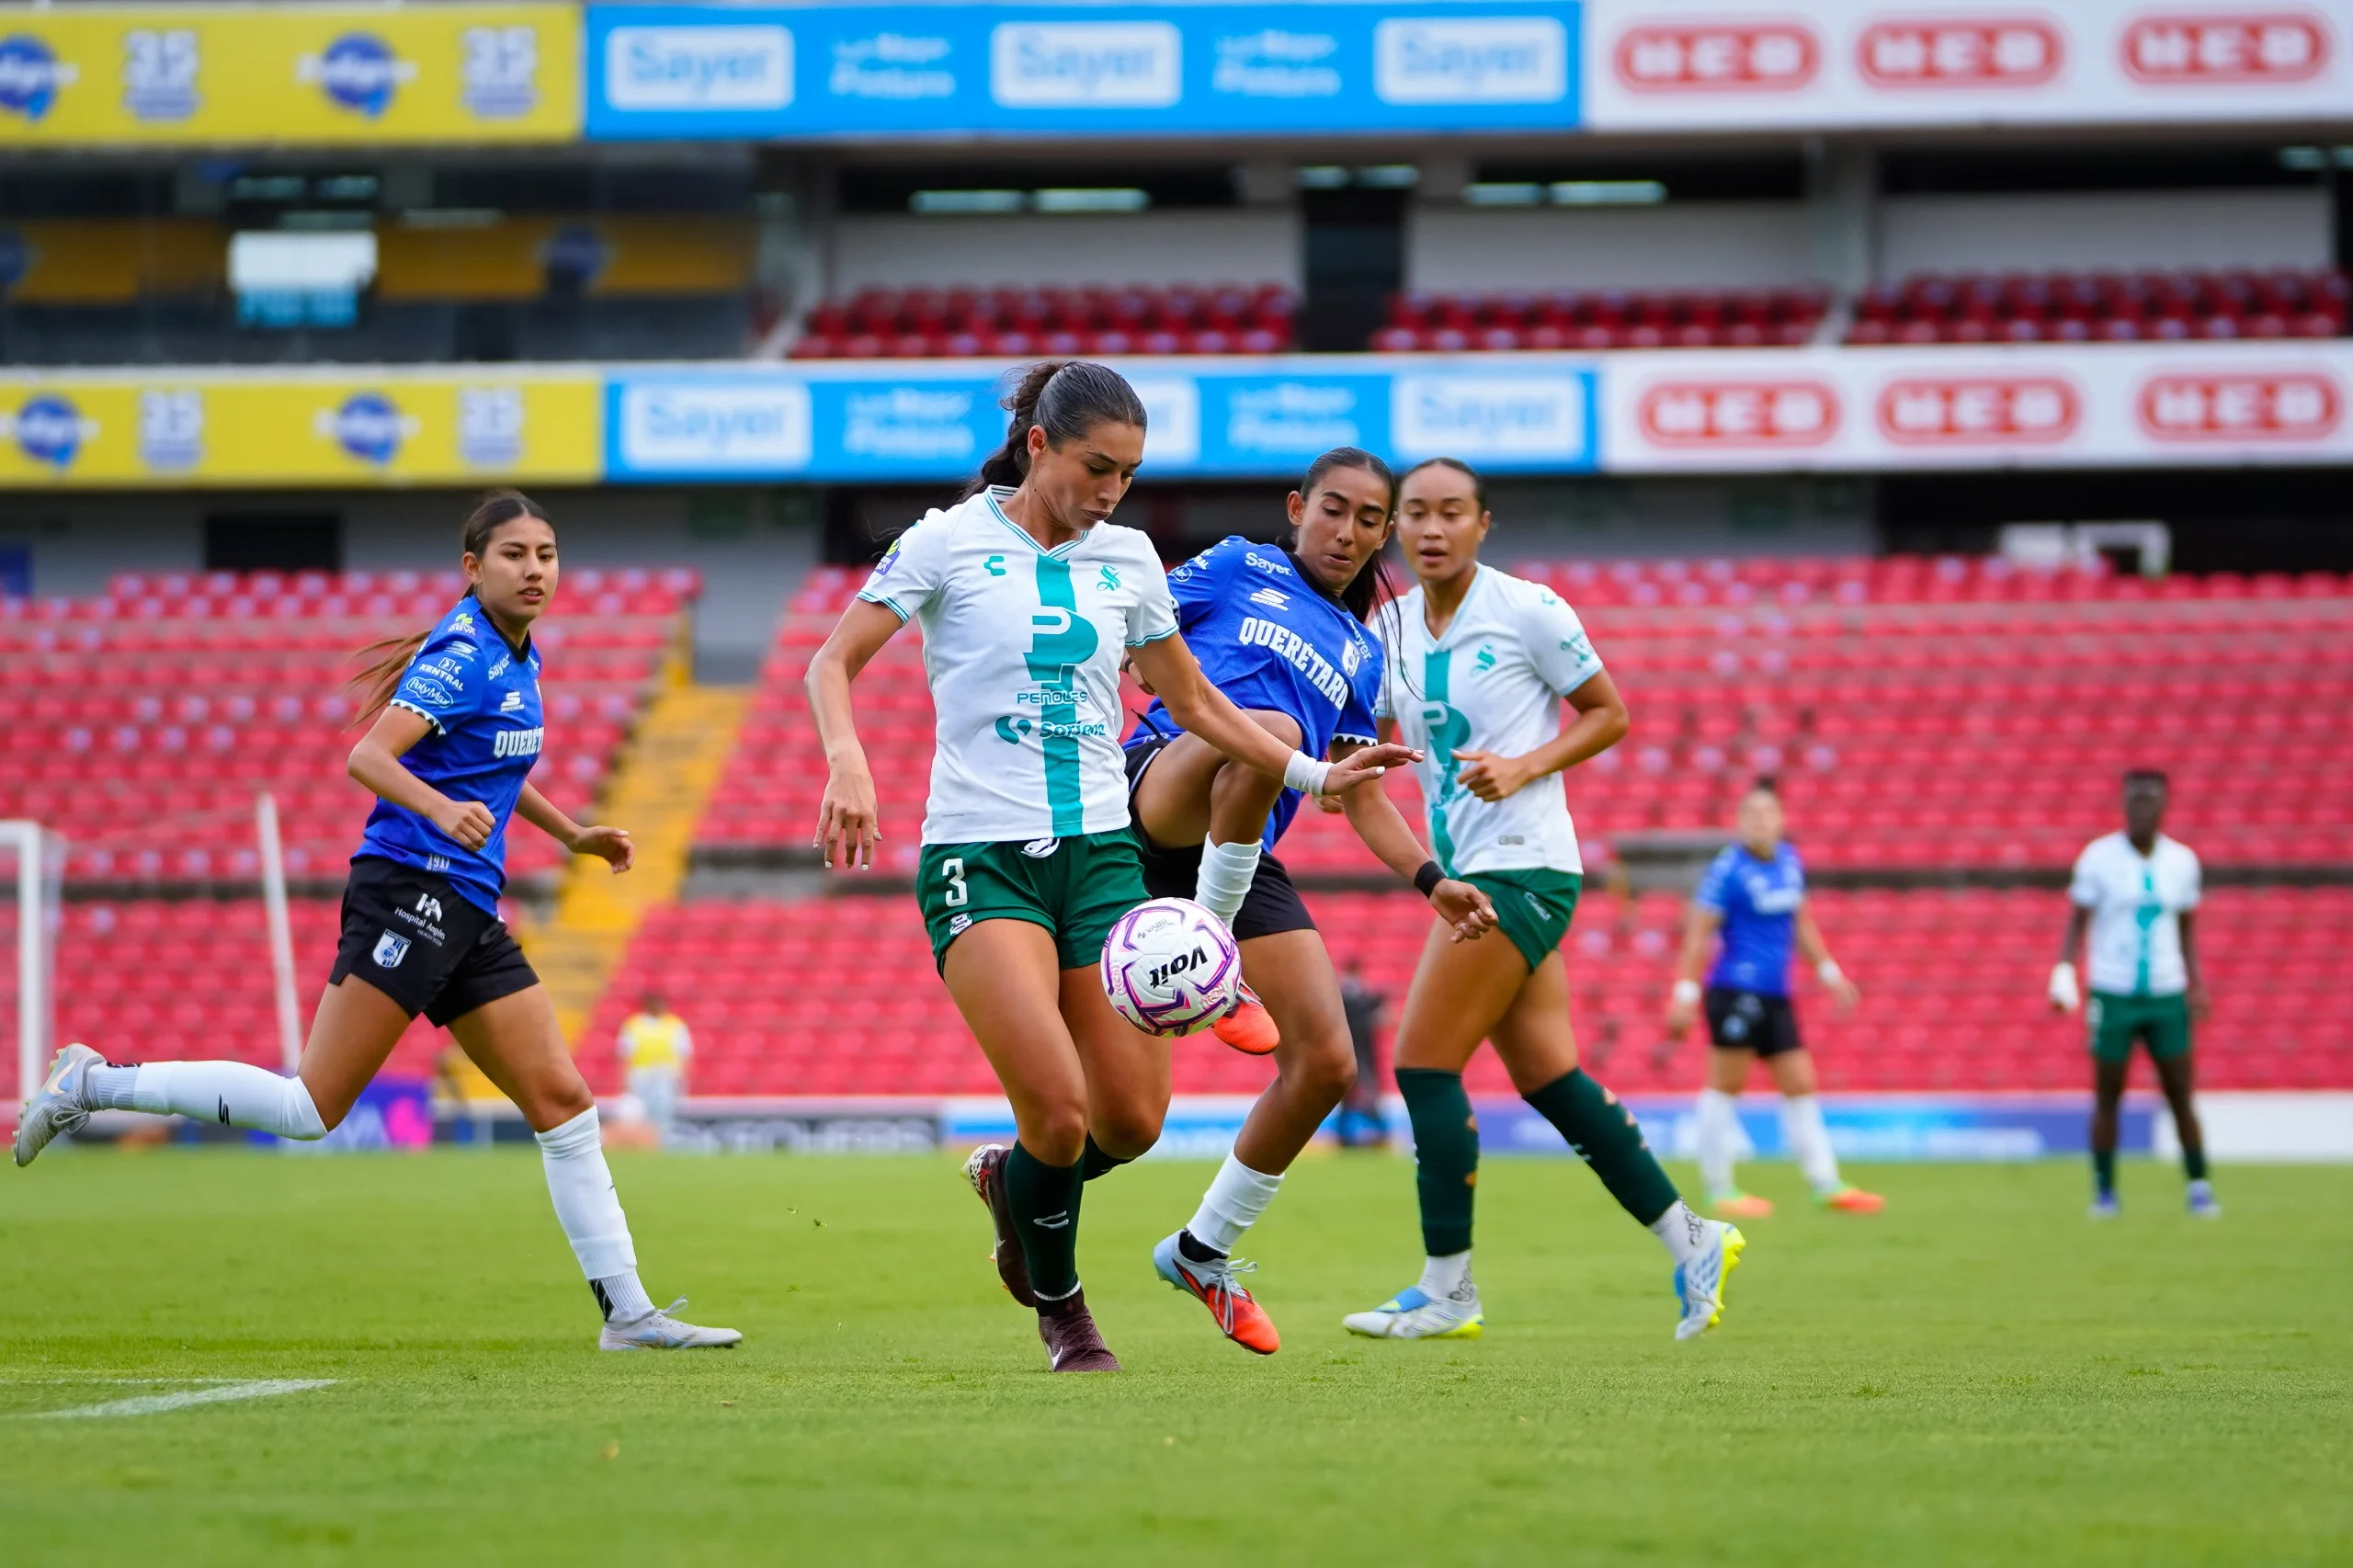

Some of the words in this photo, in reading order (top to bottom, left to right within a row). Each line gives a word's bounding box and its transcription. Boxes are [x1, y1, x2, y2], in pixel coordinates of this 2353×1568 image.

[419, 663, 464, 691] XENTRAL
[942, 858, 968, 907] 3
[394, 906, 426, 927] Hospital
[1149, 945, 1209, 990] Voit
